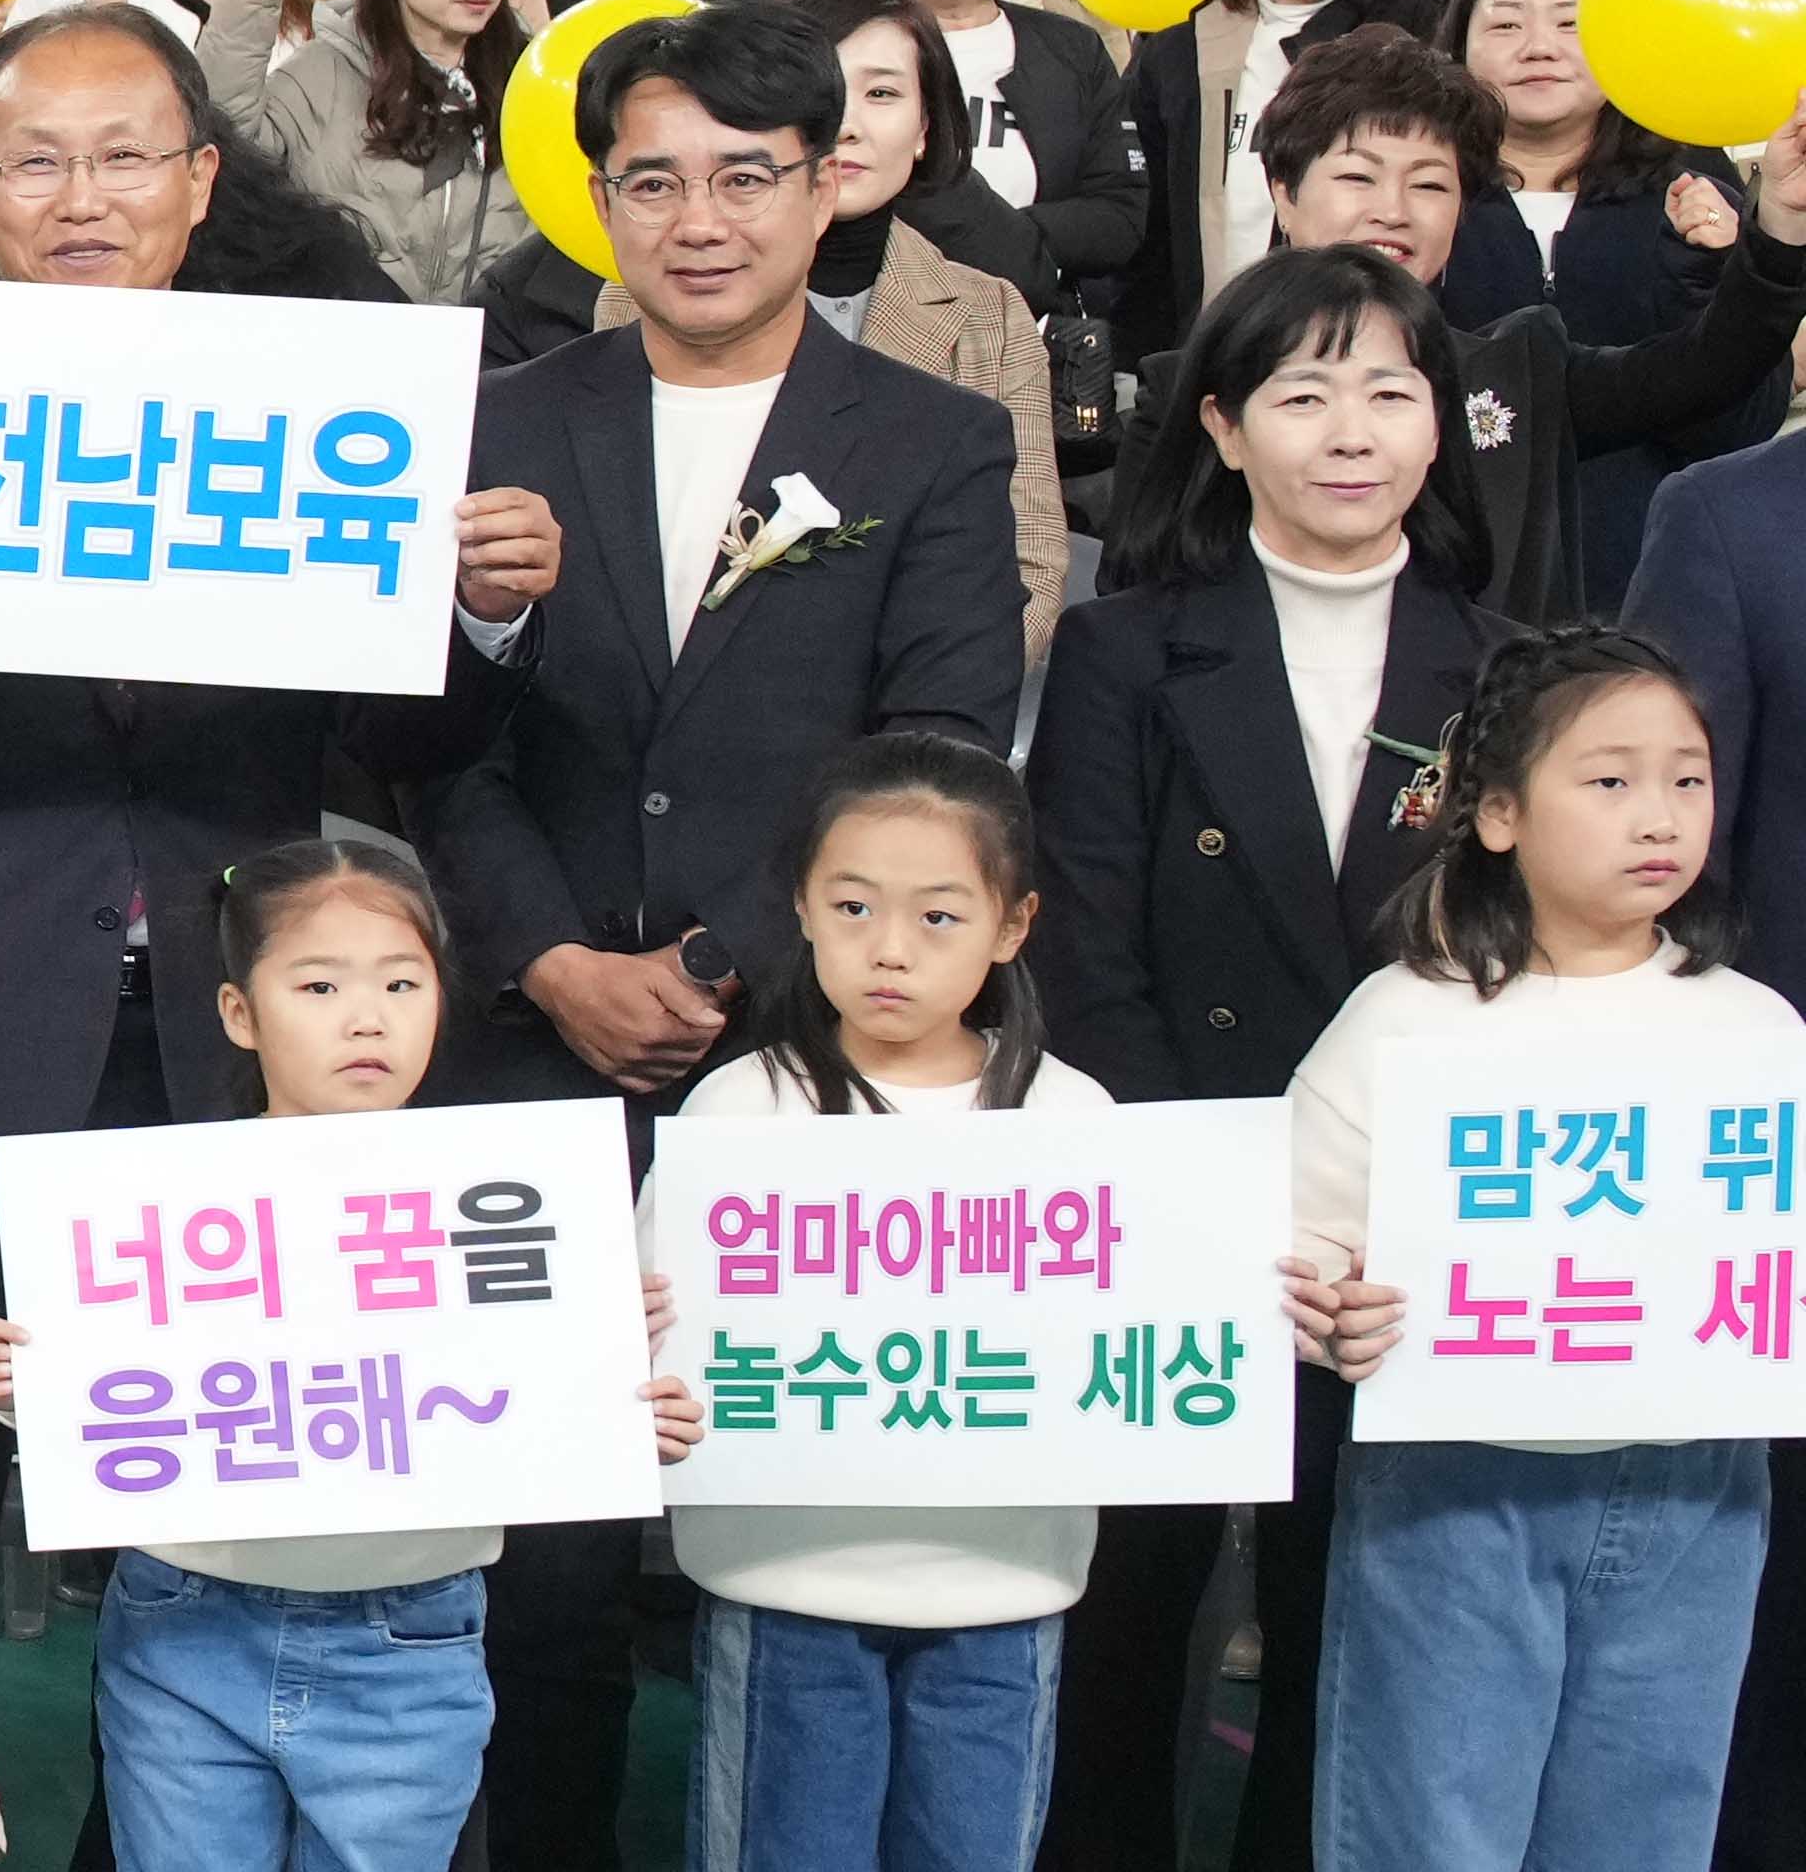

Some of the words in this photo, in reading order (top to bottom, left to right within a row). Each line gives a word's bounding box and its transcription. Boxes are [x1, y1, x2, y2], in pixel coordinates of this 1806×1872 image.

[1447, 1104, 1649, 1221] 맘껏
[73, 1198, 284, 1327] 너의
[338, 1178, 559, 1312] 꿈을
[707, 1184, 1123, 1296] 엄마아빠와
[1432, 1255, 1645, 1364] 노는
[703, 1328, 1037, 1432] 놀수있는
[1078, 1320, 1246, 1428] 세상
